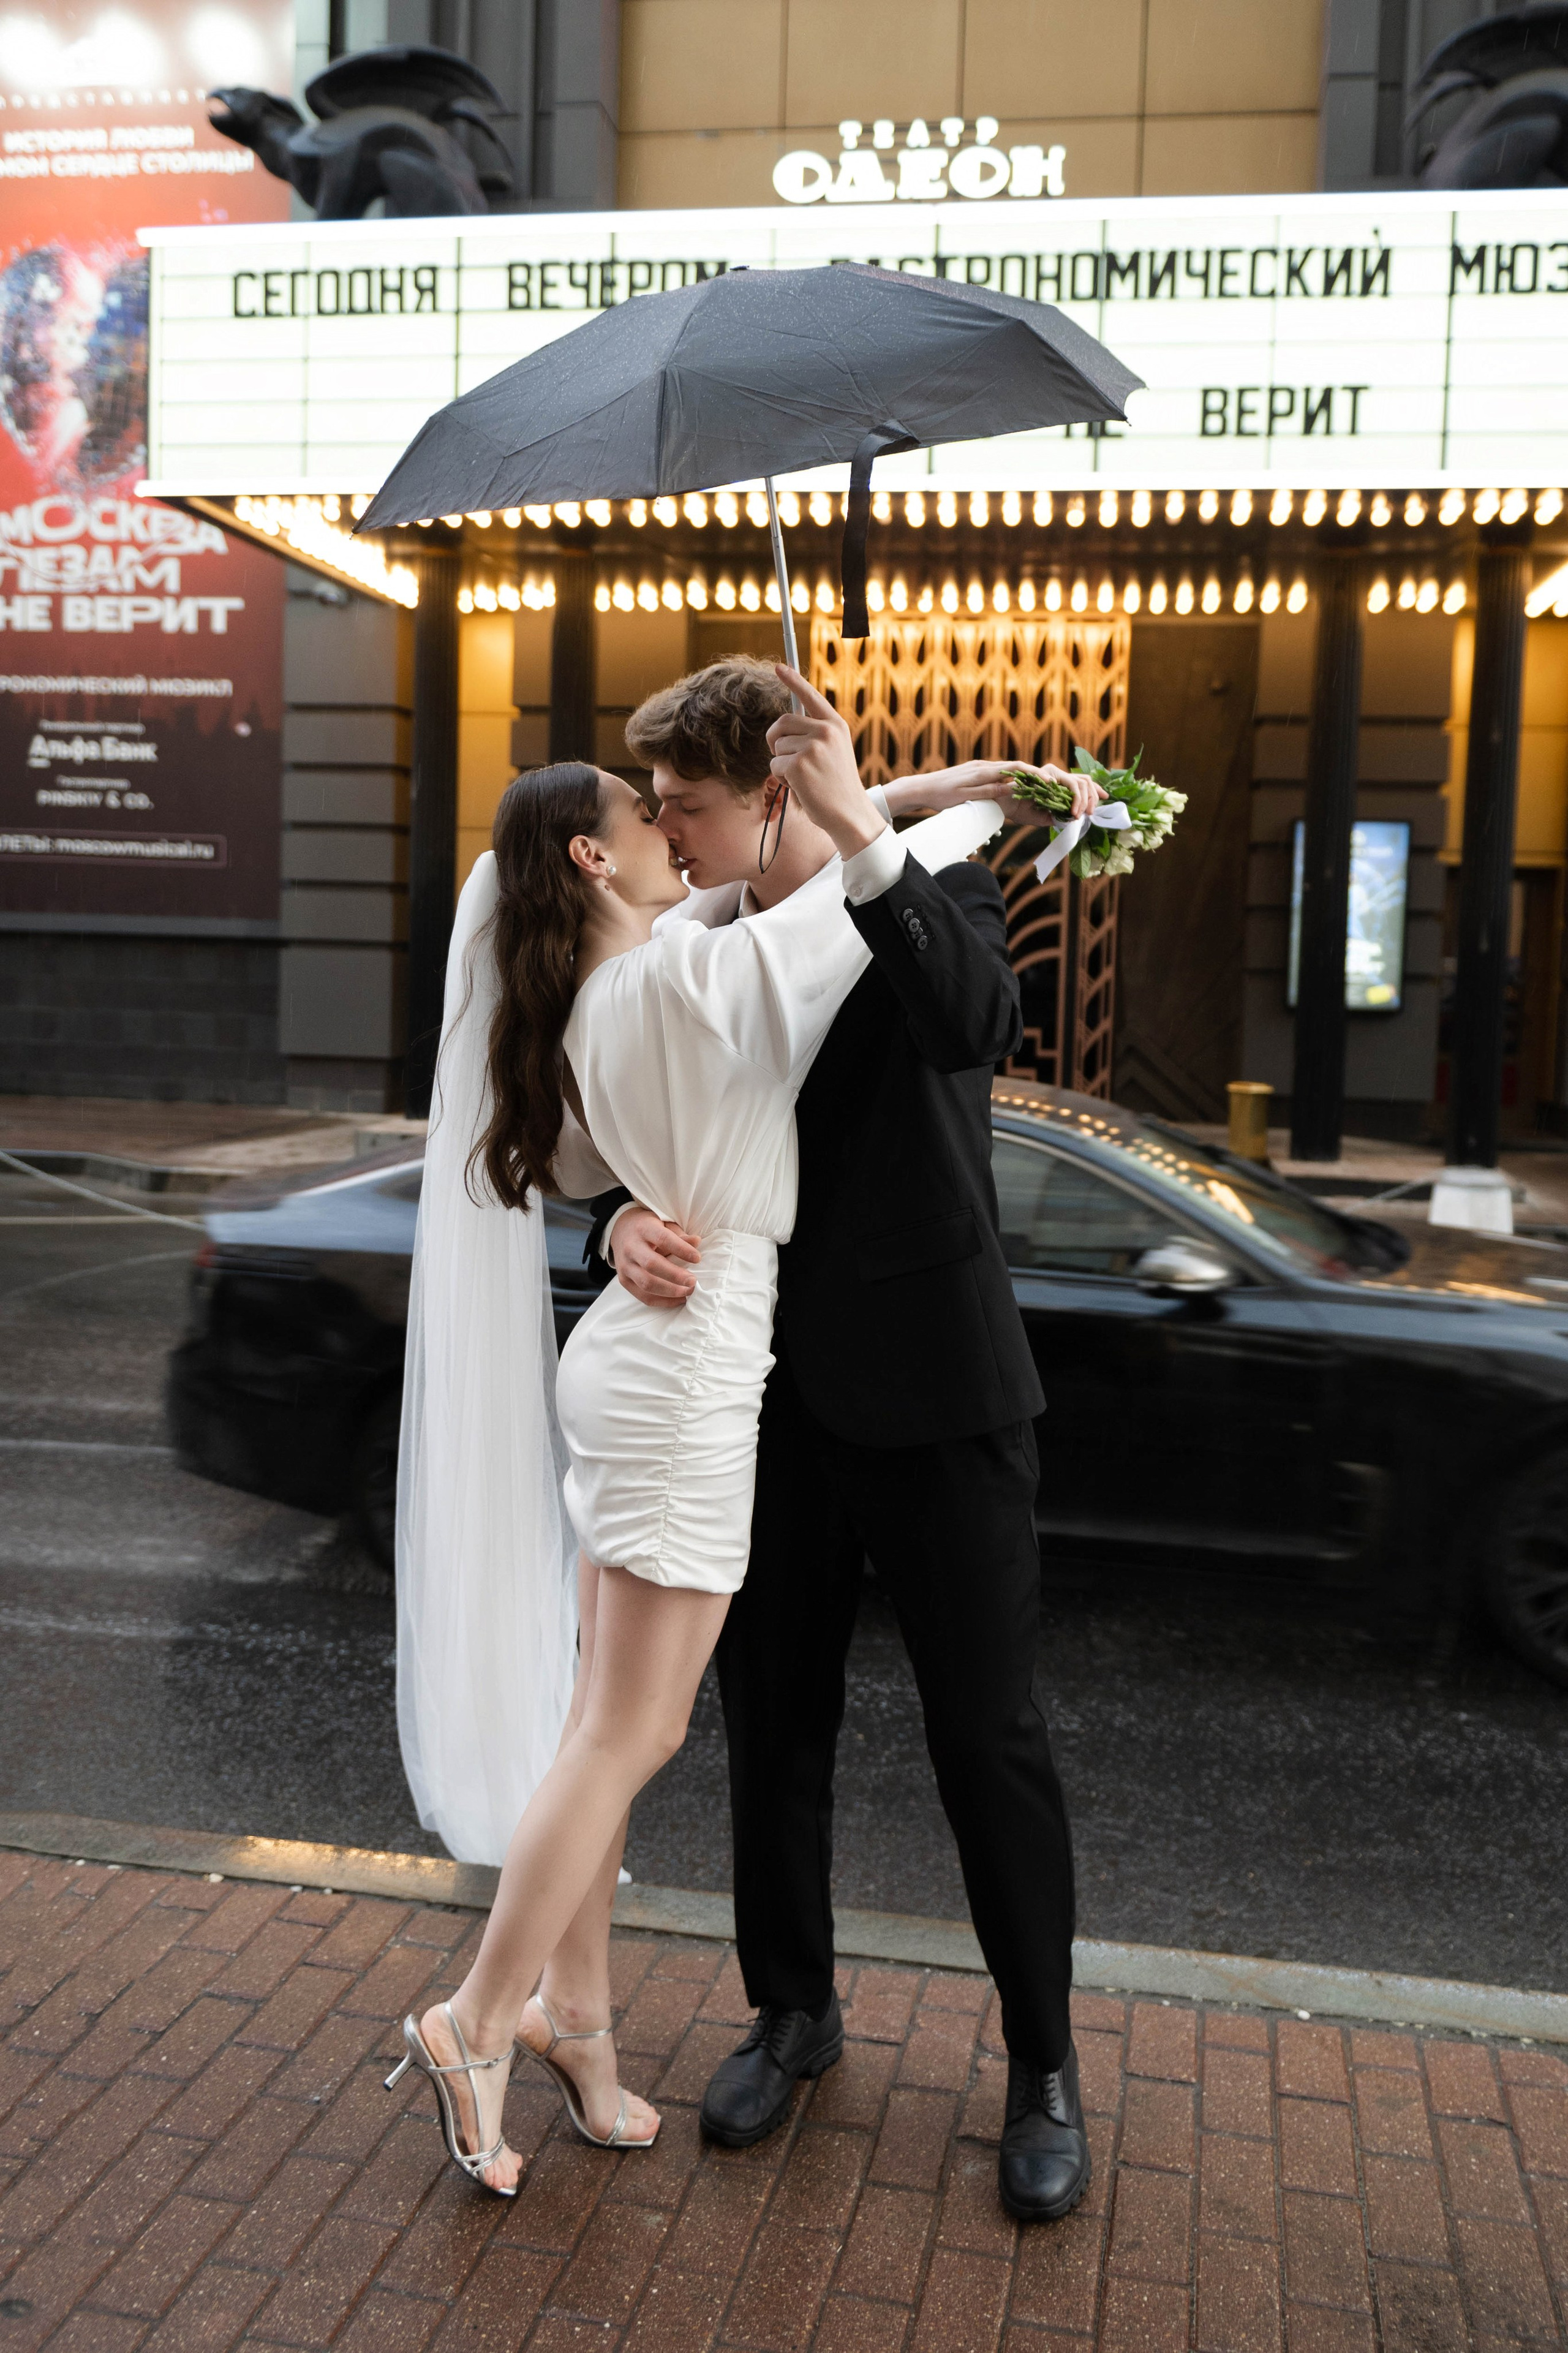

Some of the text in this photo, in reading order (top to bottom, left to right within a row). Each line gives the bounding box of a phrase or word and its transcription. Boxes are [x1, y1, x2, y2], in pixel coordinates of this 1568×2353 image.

[4, 126, 194, 153] ИСТОРИЯ ЛЮБВИ
[839, 116, 998, 149] ТЕАТР
[51, 152, 139, 177] СЕРДЦЕ
[140, 149, 254, 175] СТОЛИЦЫ
[772, 145, 1066, 203] ОДЕОН
[233, 265, 439, 317] СЕГОДНЯ
[1200, 385, 1370, 437] ВЕРИТ
[0, 495, 228, 554] МОСКВА
[62, 595, 244, 634] ВЕРИТ
[149, 678, 233, 697] МЮЗИКЛ
[105, 790, 121, 809] &
